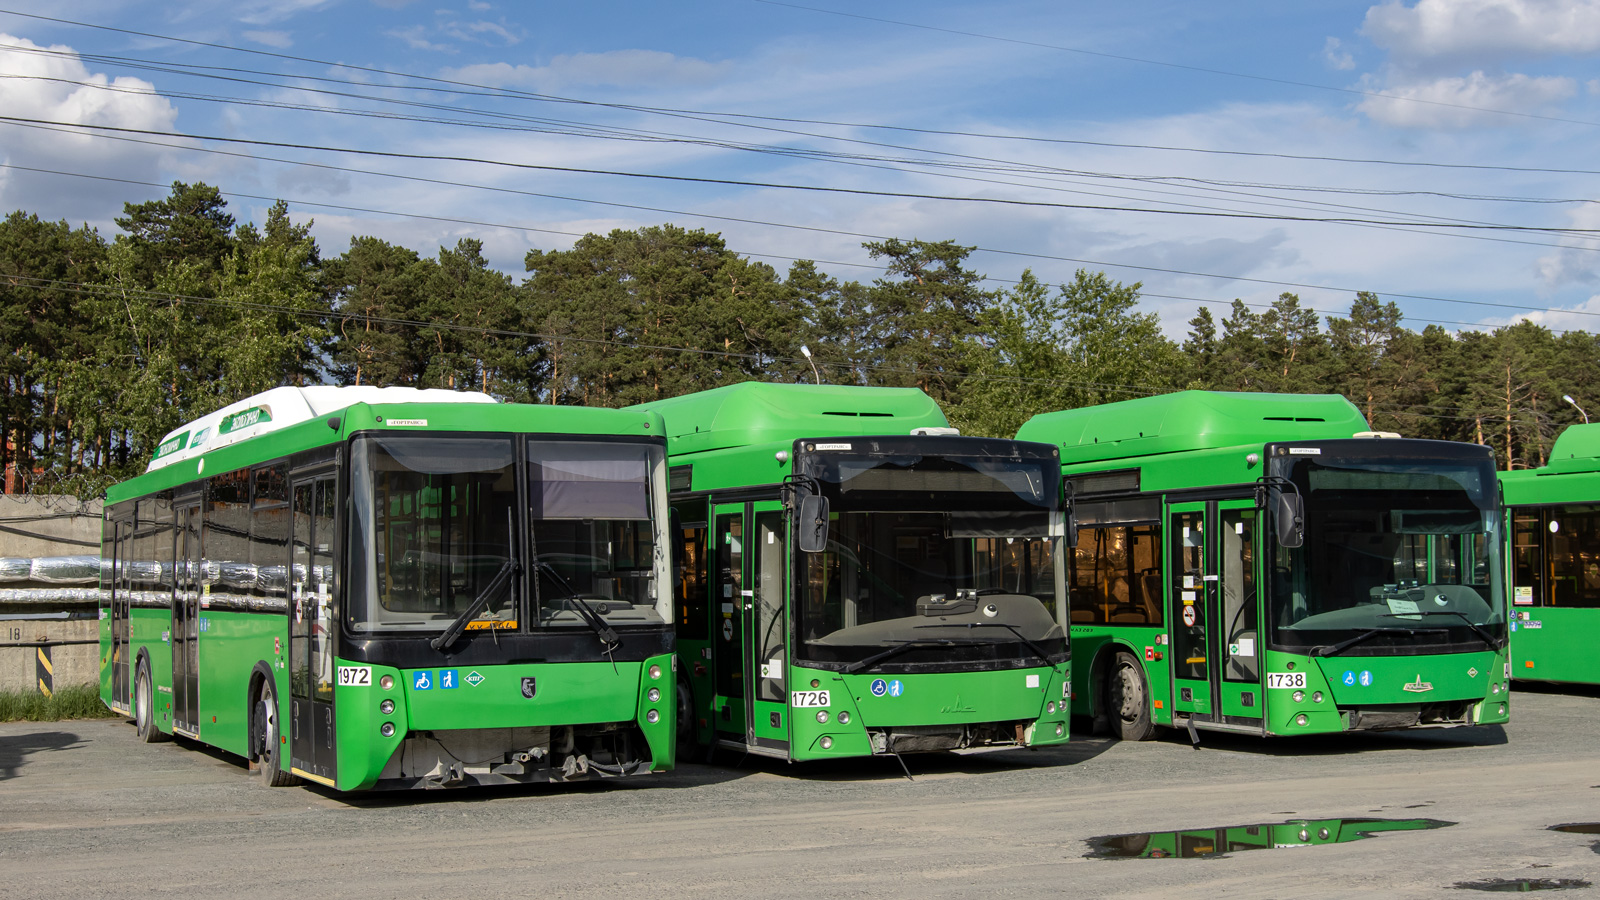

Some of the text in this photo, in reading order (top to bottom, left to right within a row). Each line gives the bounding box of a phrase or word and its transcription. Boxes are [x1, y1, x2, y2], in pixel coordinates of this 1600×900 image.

[9, 627, 20, 641] 18
[339, 668, 369, 684] 1972
[1269, 674, 1303, 687] 1738
[793, 692, 827, 706] 1726
